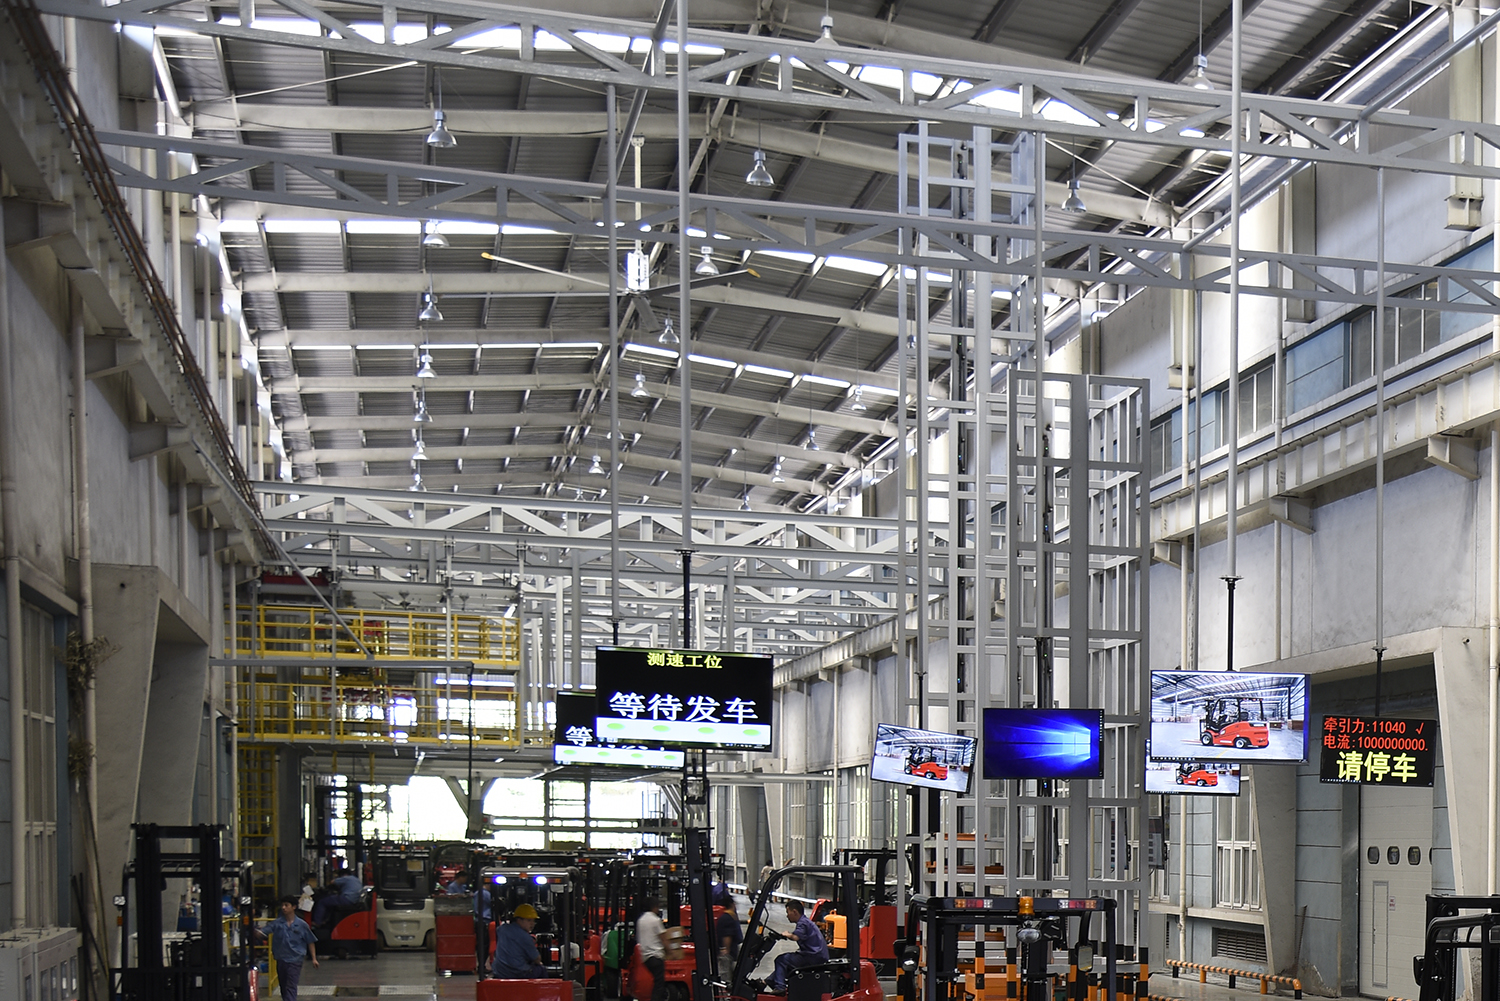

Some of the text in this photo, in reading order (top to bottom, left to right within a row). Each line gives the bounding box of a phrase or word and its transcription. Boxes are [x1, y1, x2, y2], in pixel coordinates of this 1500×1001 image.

[646, 652, 723, 669] 测速工位
[609, 691, 759, 724] 等待发车
[1336, 750, 1418, 783] 请停车
